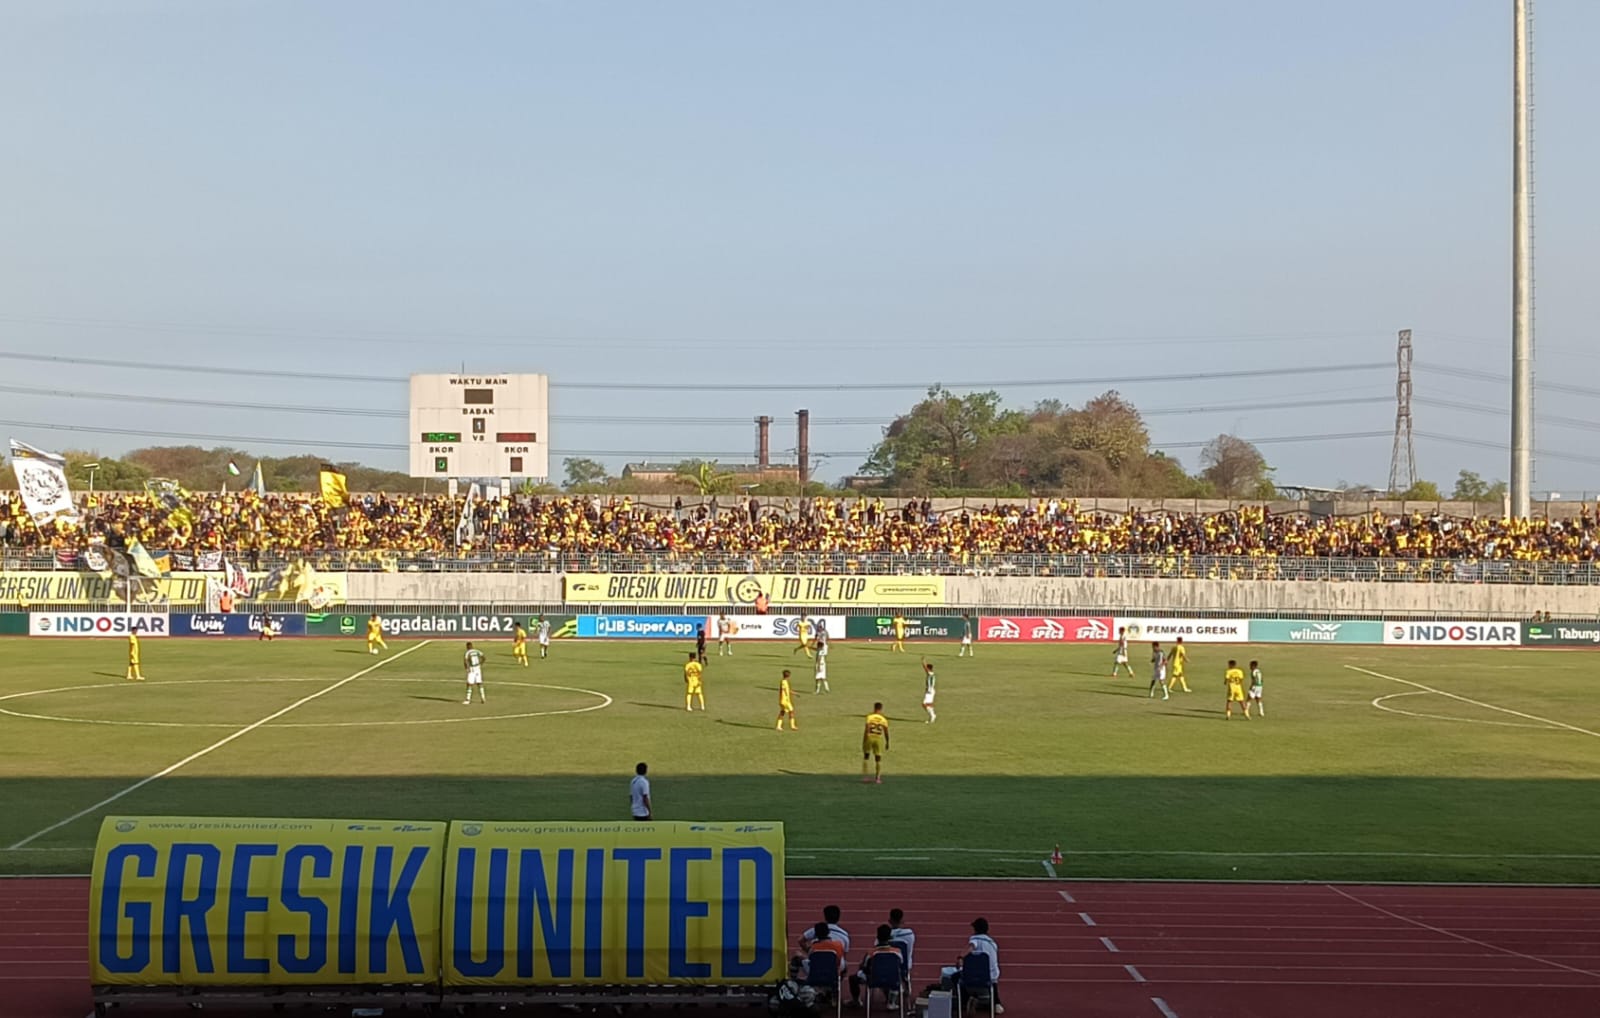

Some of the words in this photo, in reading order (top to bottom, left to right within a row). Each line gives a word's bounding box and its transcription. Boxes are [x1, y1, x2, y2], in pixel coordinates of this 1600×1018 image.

[607, 576, 662, 599] GRESIK
[664, 576, 718, 600] UNITED
[782, 577, 800, 600] TO
[805, 578, 833, 600] THE
[838, 578, 866, 600] TOP
[56, 617, 164, 632] INDOSIAR
[462, 617, 500, 632] LIGA
[503, 617, 513, 632] 2
[627, 620, 665, 635] Super
[665, 620, 692, 635] App
[923, 625, 948, 636] Emas
[1146, 625, 1193, 634] PEMKAB
[1196, 626, 1238, 635] GRESIK
[987, 630, 1020, 639] SPECS
[1031, 630, 1064, 639] SPECS
[1076, 630, 1109, 639] SPECS
[1290, 628, 1337, 640] wilmar
[1409, 626, 1516, 641] INDOSIAR
[1557, 627, 1600, 642] Tabung
[148, 821, 313, 831] www.gresikunited.com
[494, 825, 656, 834] www.gresikunited.com
[99, 842, 431, 974] GRESIK
[452, 846, 774, 979] UNITED
